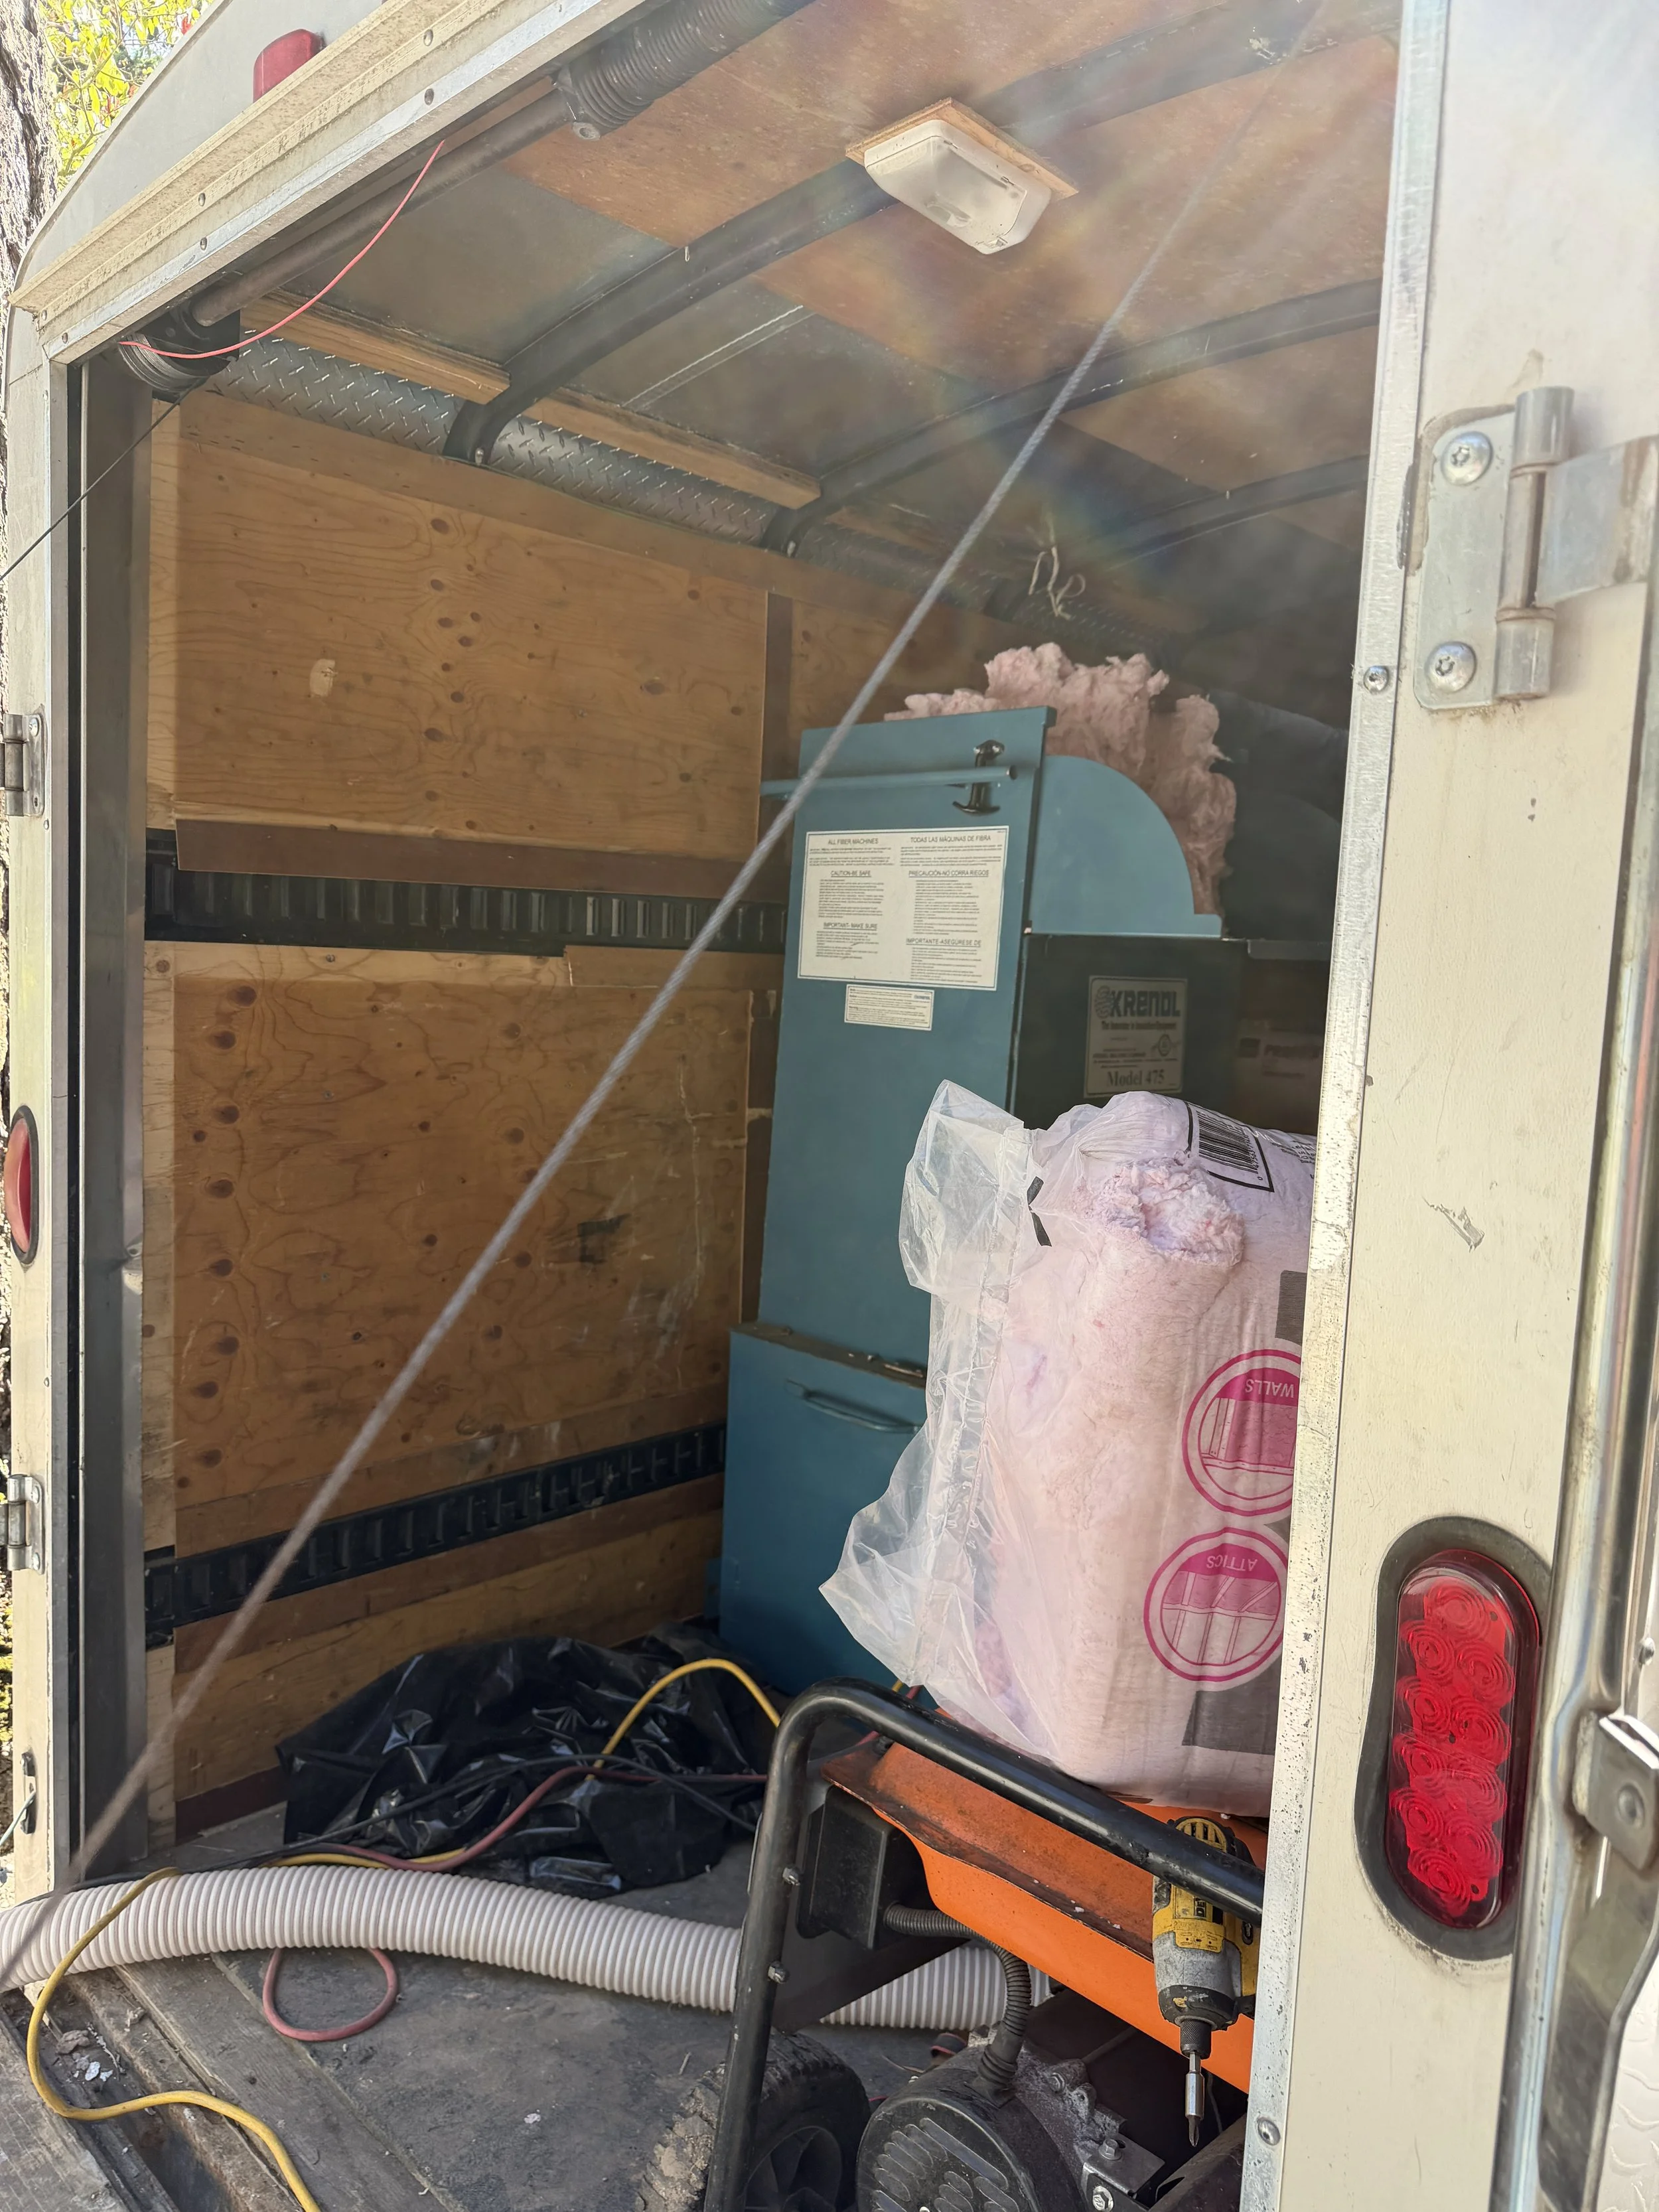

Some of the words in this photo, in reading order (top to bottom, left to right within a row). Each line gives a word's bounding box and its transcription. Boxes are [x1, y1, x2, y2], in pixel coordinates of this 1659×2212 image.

[1107, 1069, 1143, 1087] Model
[1145, 1069, 1165, 1084] 475
[1244, 1378, 1295, 1398] WALLS
[1206, 1554, 1258, 1572] ATTICS
